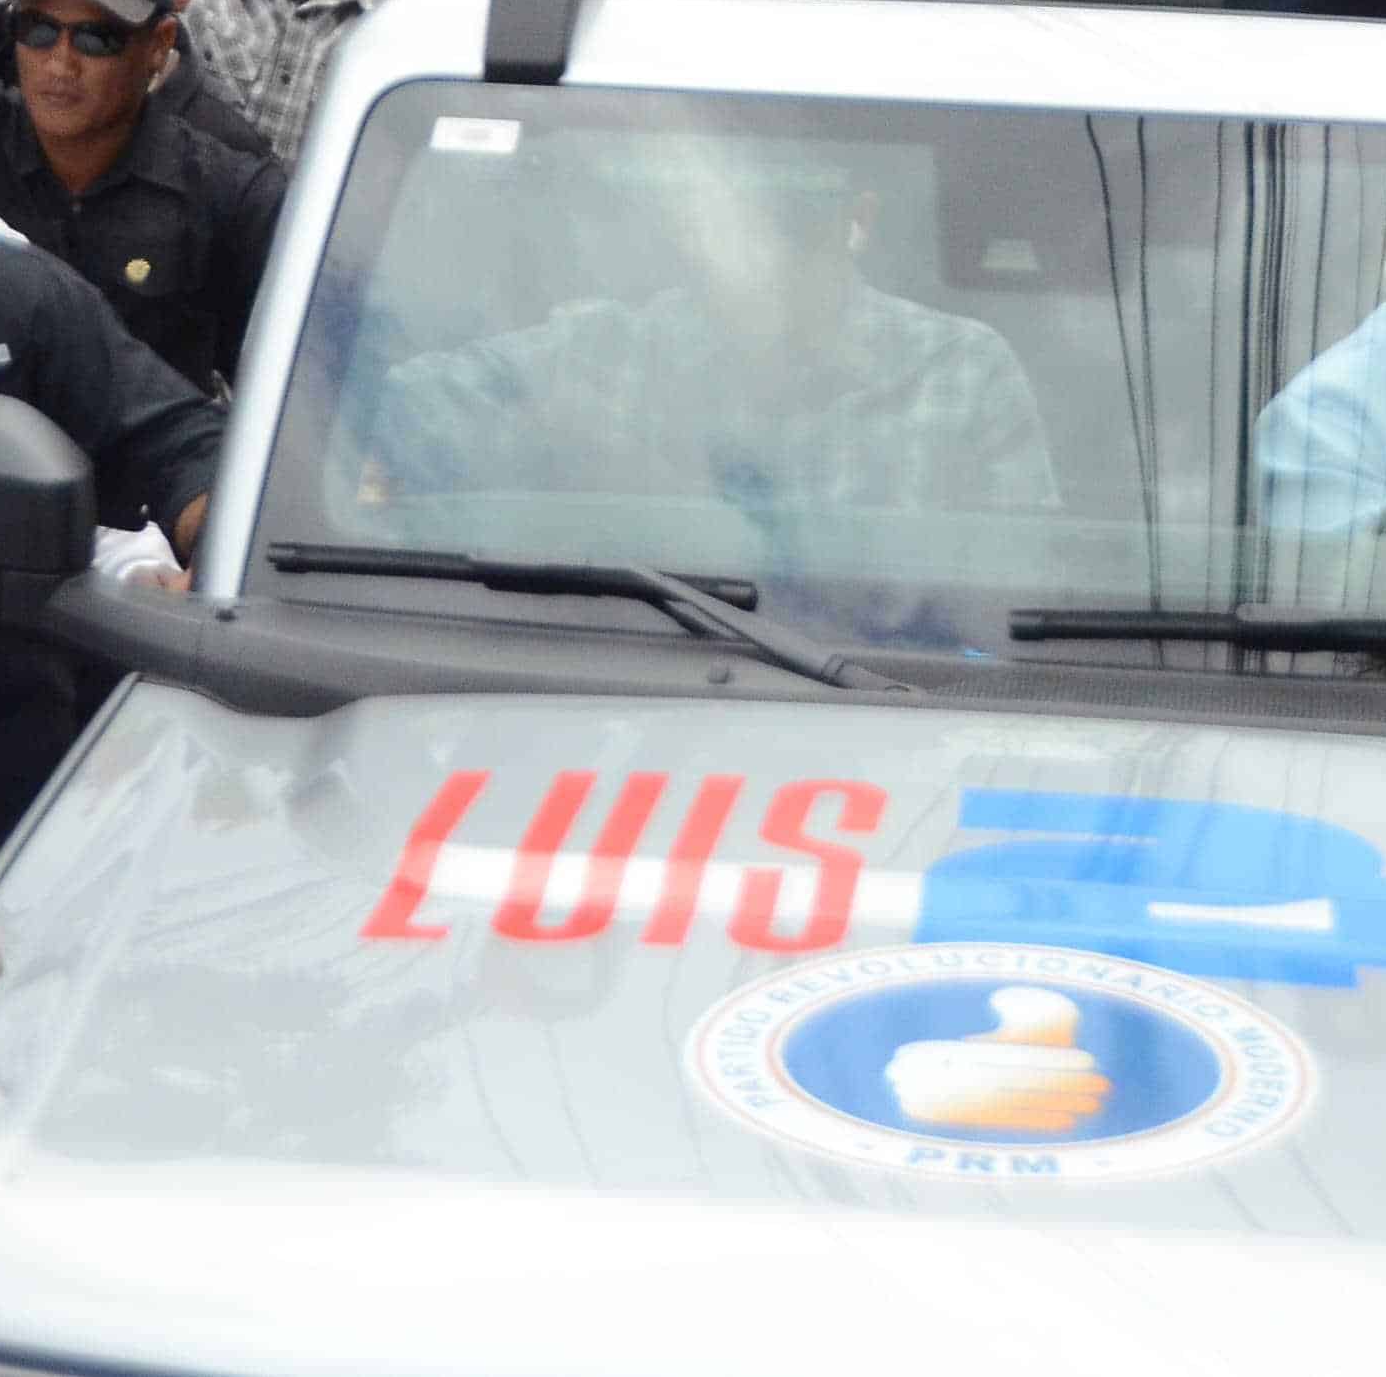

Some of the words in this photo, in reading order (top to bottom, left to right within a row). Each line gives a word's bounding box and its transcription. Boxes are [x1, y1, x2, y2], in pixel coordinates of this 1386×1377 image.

[357, 768, 891, 955] LUIS
[719, 1010, 775, 1113] PARTIDO
[766, 950, 1230, 1020] REVOLUCIONARIO
[1207, 1010, 1288, 1140] MODERNO
[905, 1146, 1061, 1176] PRM
